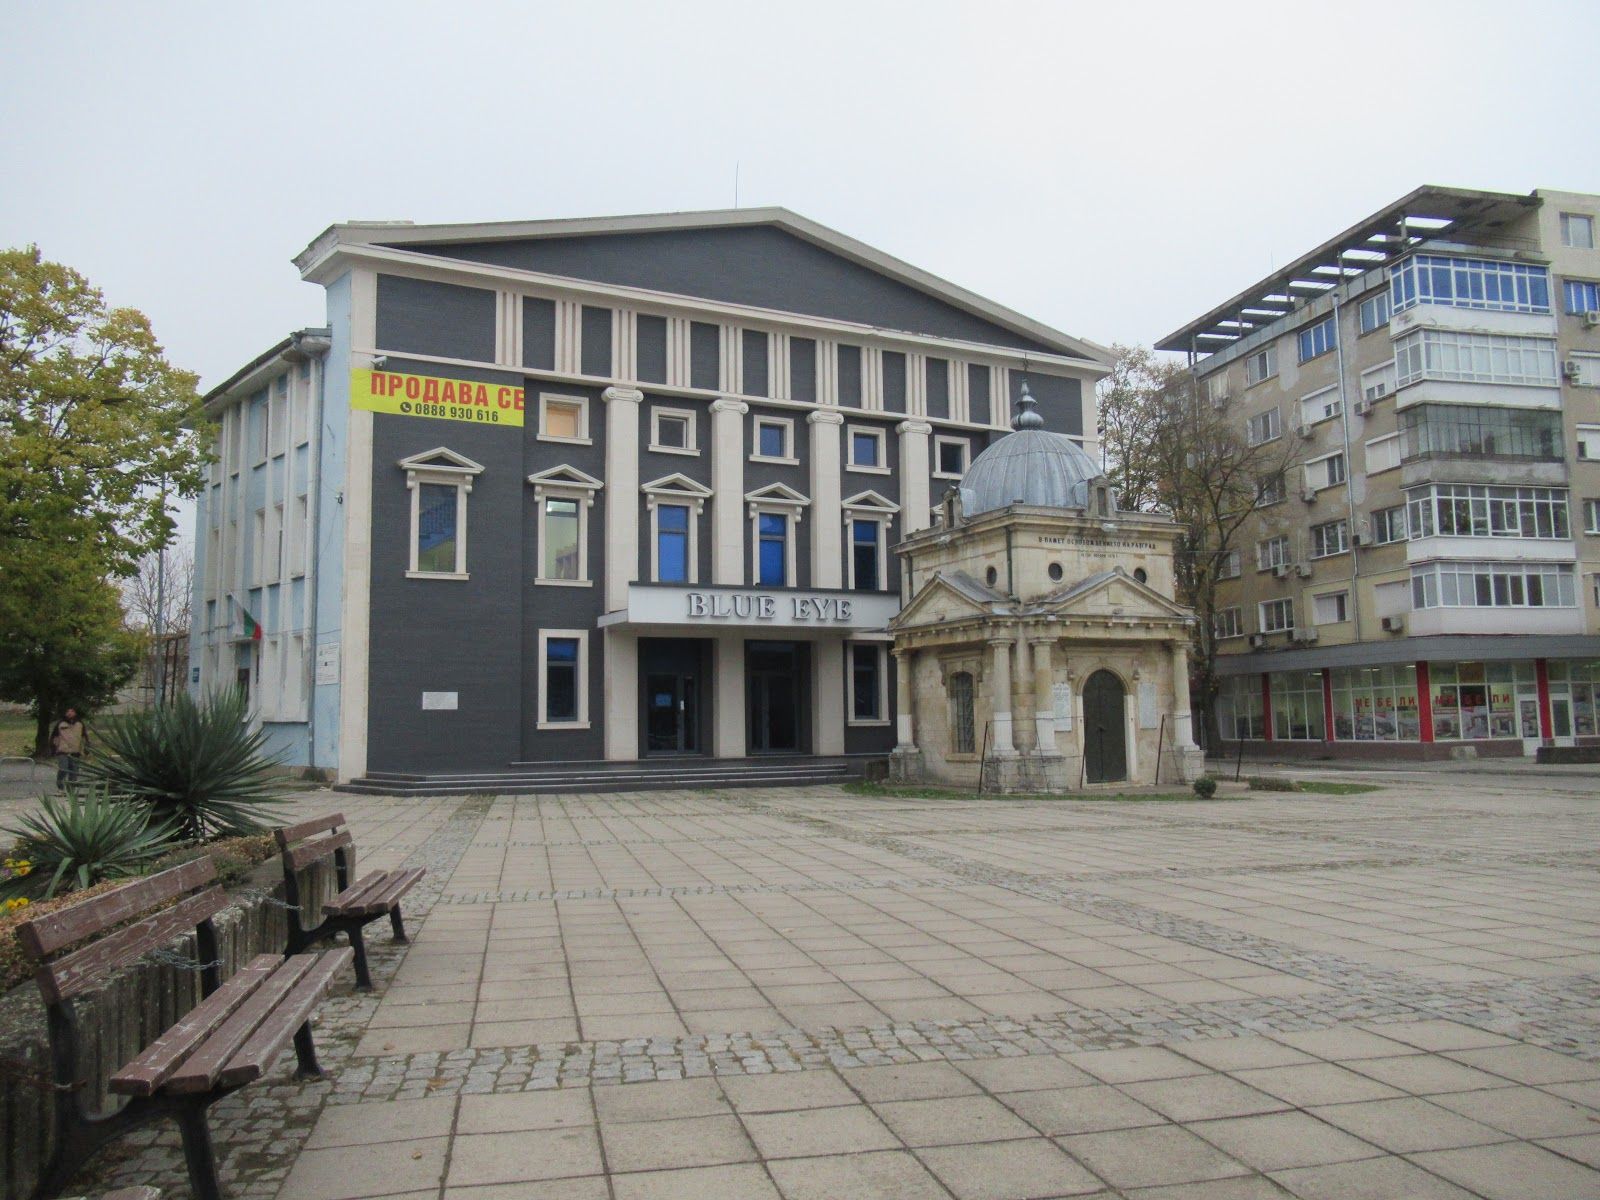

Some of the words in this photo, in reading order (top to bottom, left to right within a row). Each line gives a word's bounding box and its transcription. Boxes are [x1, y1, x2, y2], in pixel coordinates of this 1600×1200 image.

[370, 372, 489, 407] ПРОДАВА
[497, 387, 524, 411] СЕ
[415, 402, 446, 417] 0888
[450, 406, 473, 420] 930
[477, 409, 499, 422] 616
[688, 592, 775, 619] BLUE
[793, 597, 852, 621] EYE
